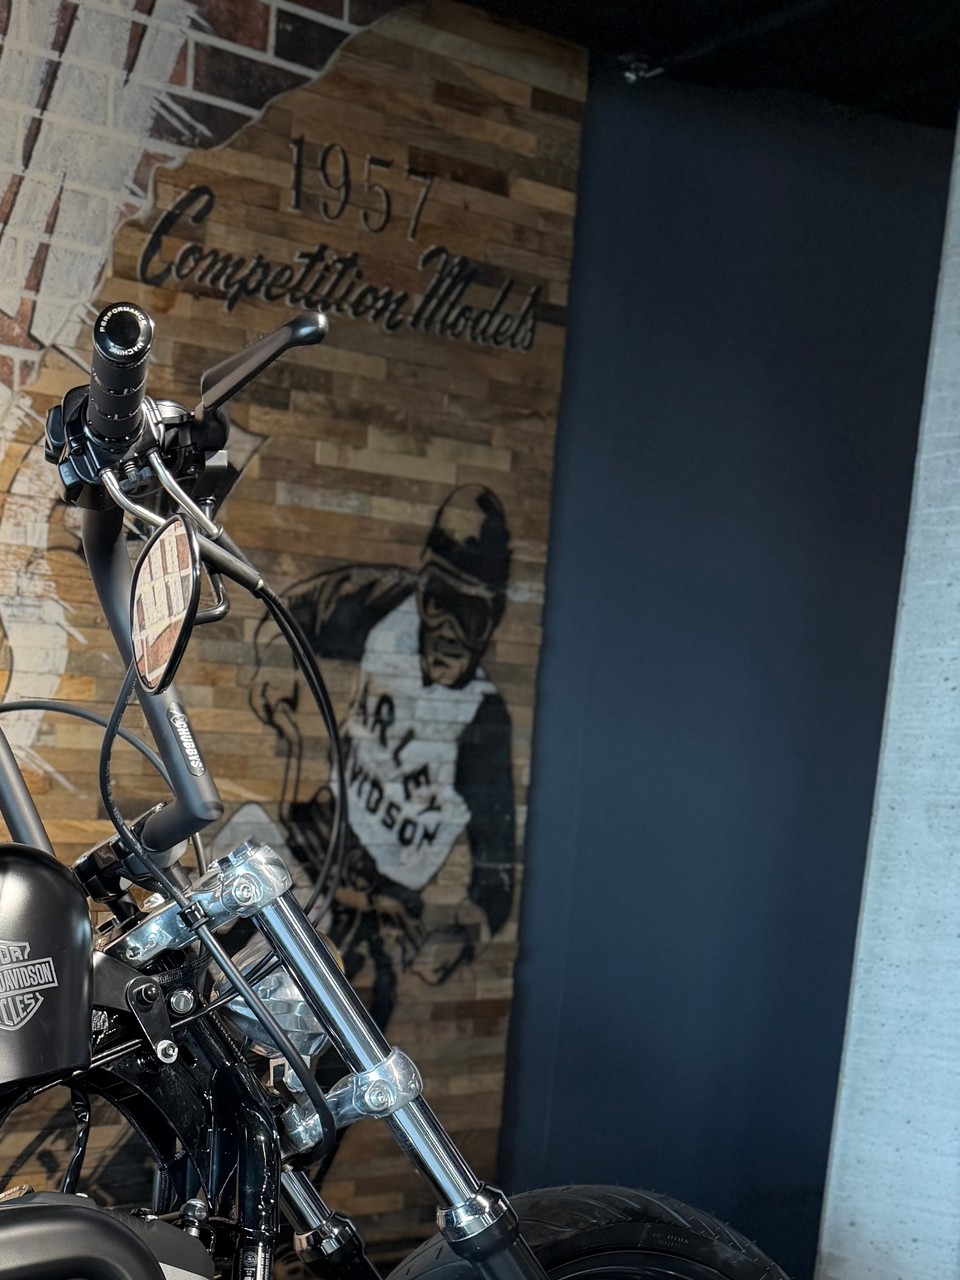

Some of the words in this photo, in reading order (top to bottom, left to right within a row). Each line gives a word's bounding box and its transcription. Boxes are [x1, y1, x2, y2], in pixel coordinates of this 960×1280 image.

[289, 133, 434, 242] 1957
[138, 185, 411, 332] Competition
[407, 244, 543, 353] Models
[100, 306, 148, 333] PERFORMANCE
[108, 342, 145, 356] MACHINE
